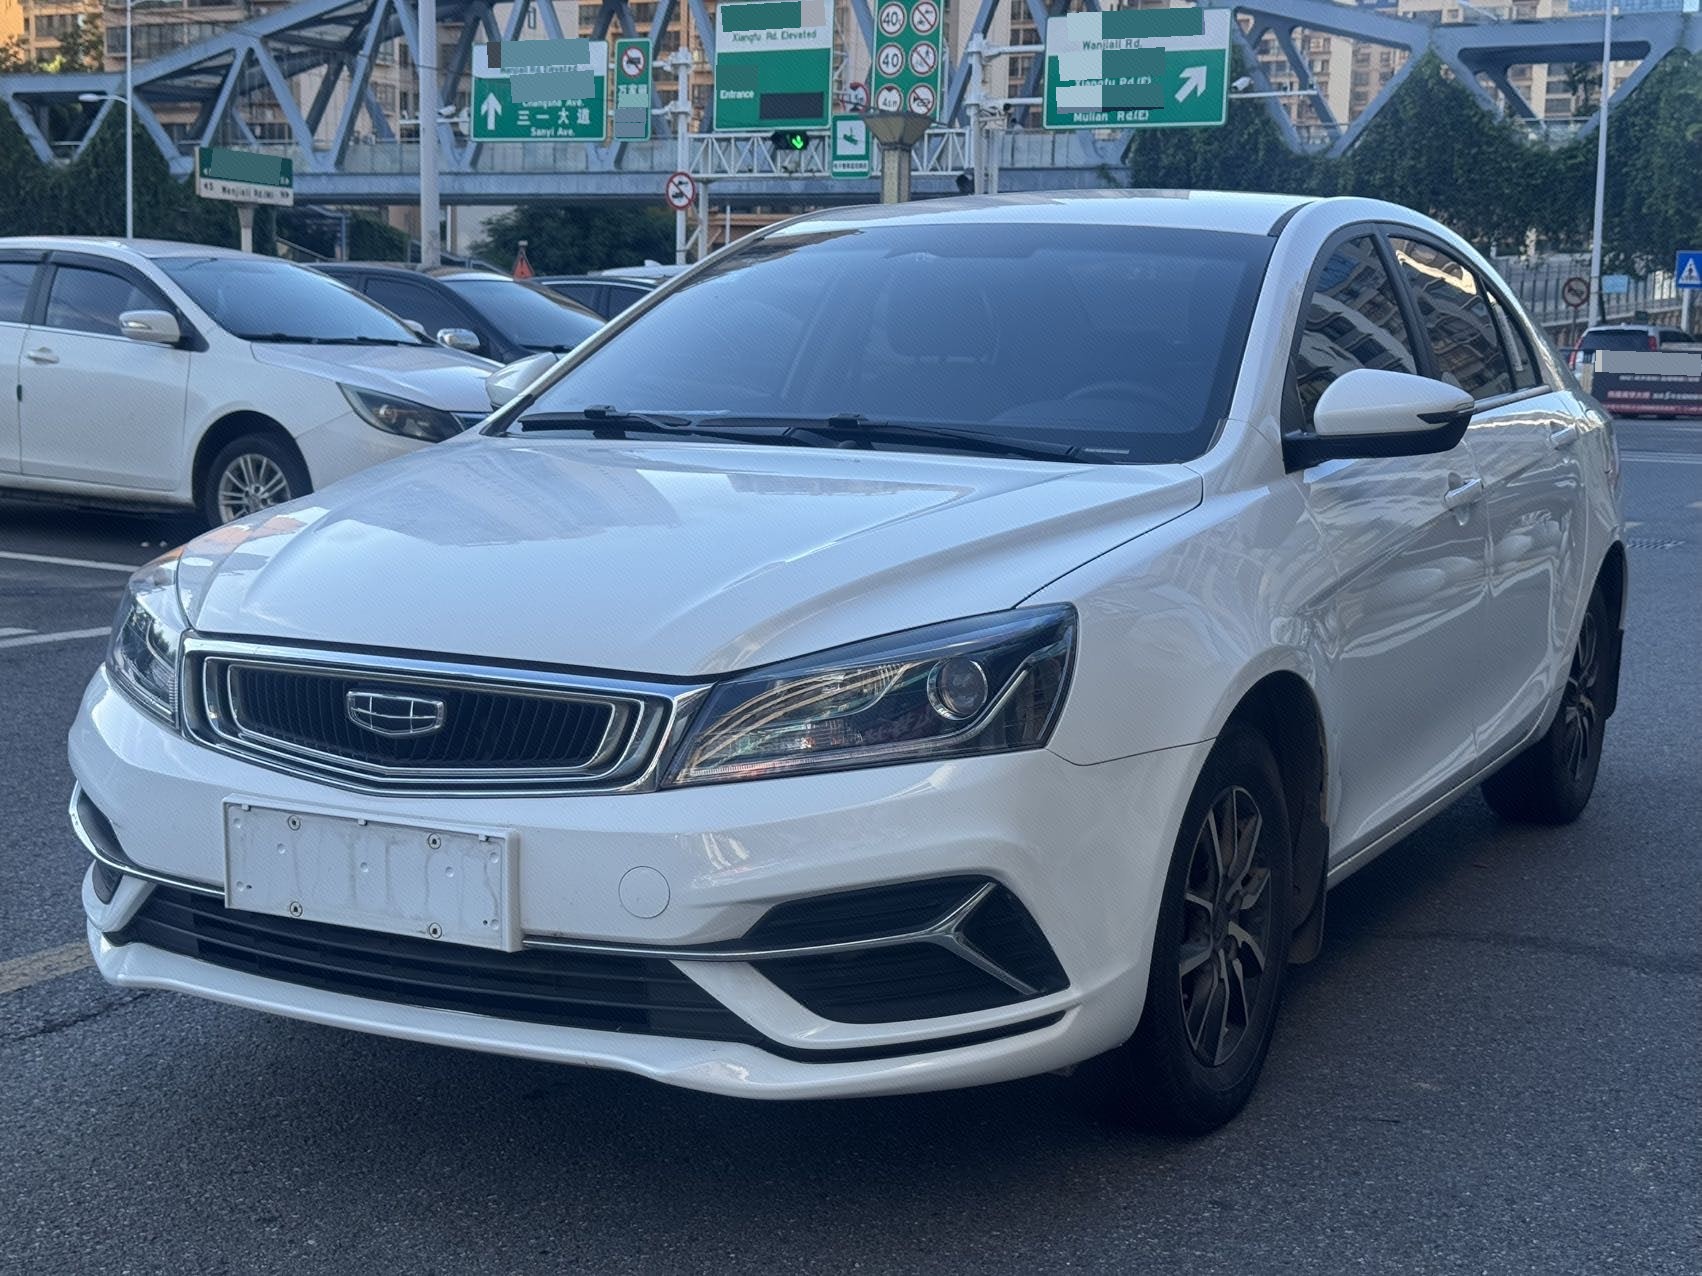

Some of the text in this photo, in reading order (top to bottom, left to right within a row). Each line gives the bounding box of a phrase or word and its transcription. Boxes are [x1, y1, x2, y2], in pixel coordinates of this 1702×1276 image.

[883, 11, 899, 26] 40
[781, 30, 817, 40] Elevated
[882, 53, 899, 68] 40
[720, 90, 754, 99] Entrance
[516, 108, 590, 125] 三一大道
[530, 127, 575, 138] Sanyi Ave.
